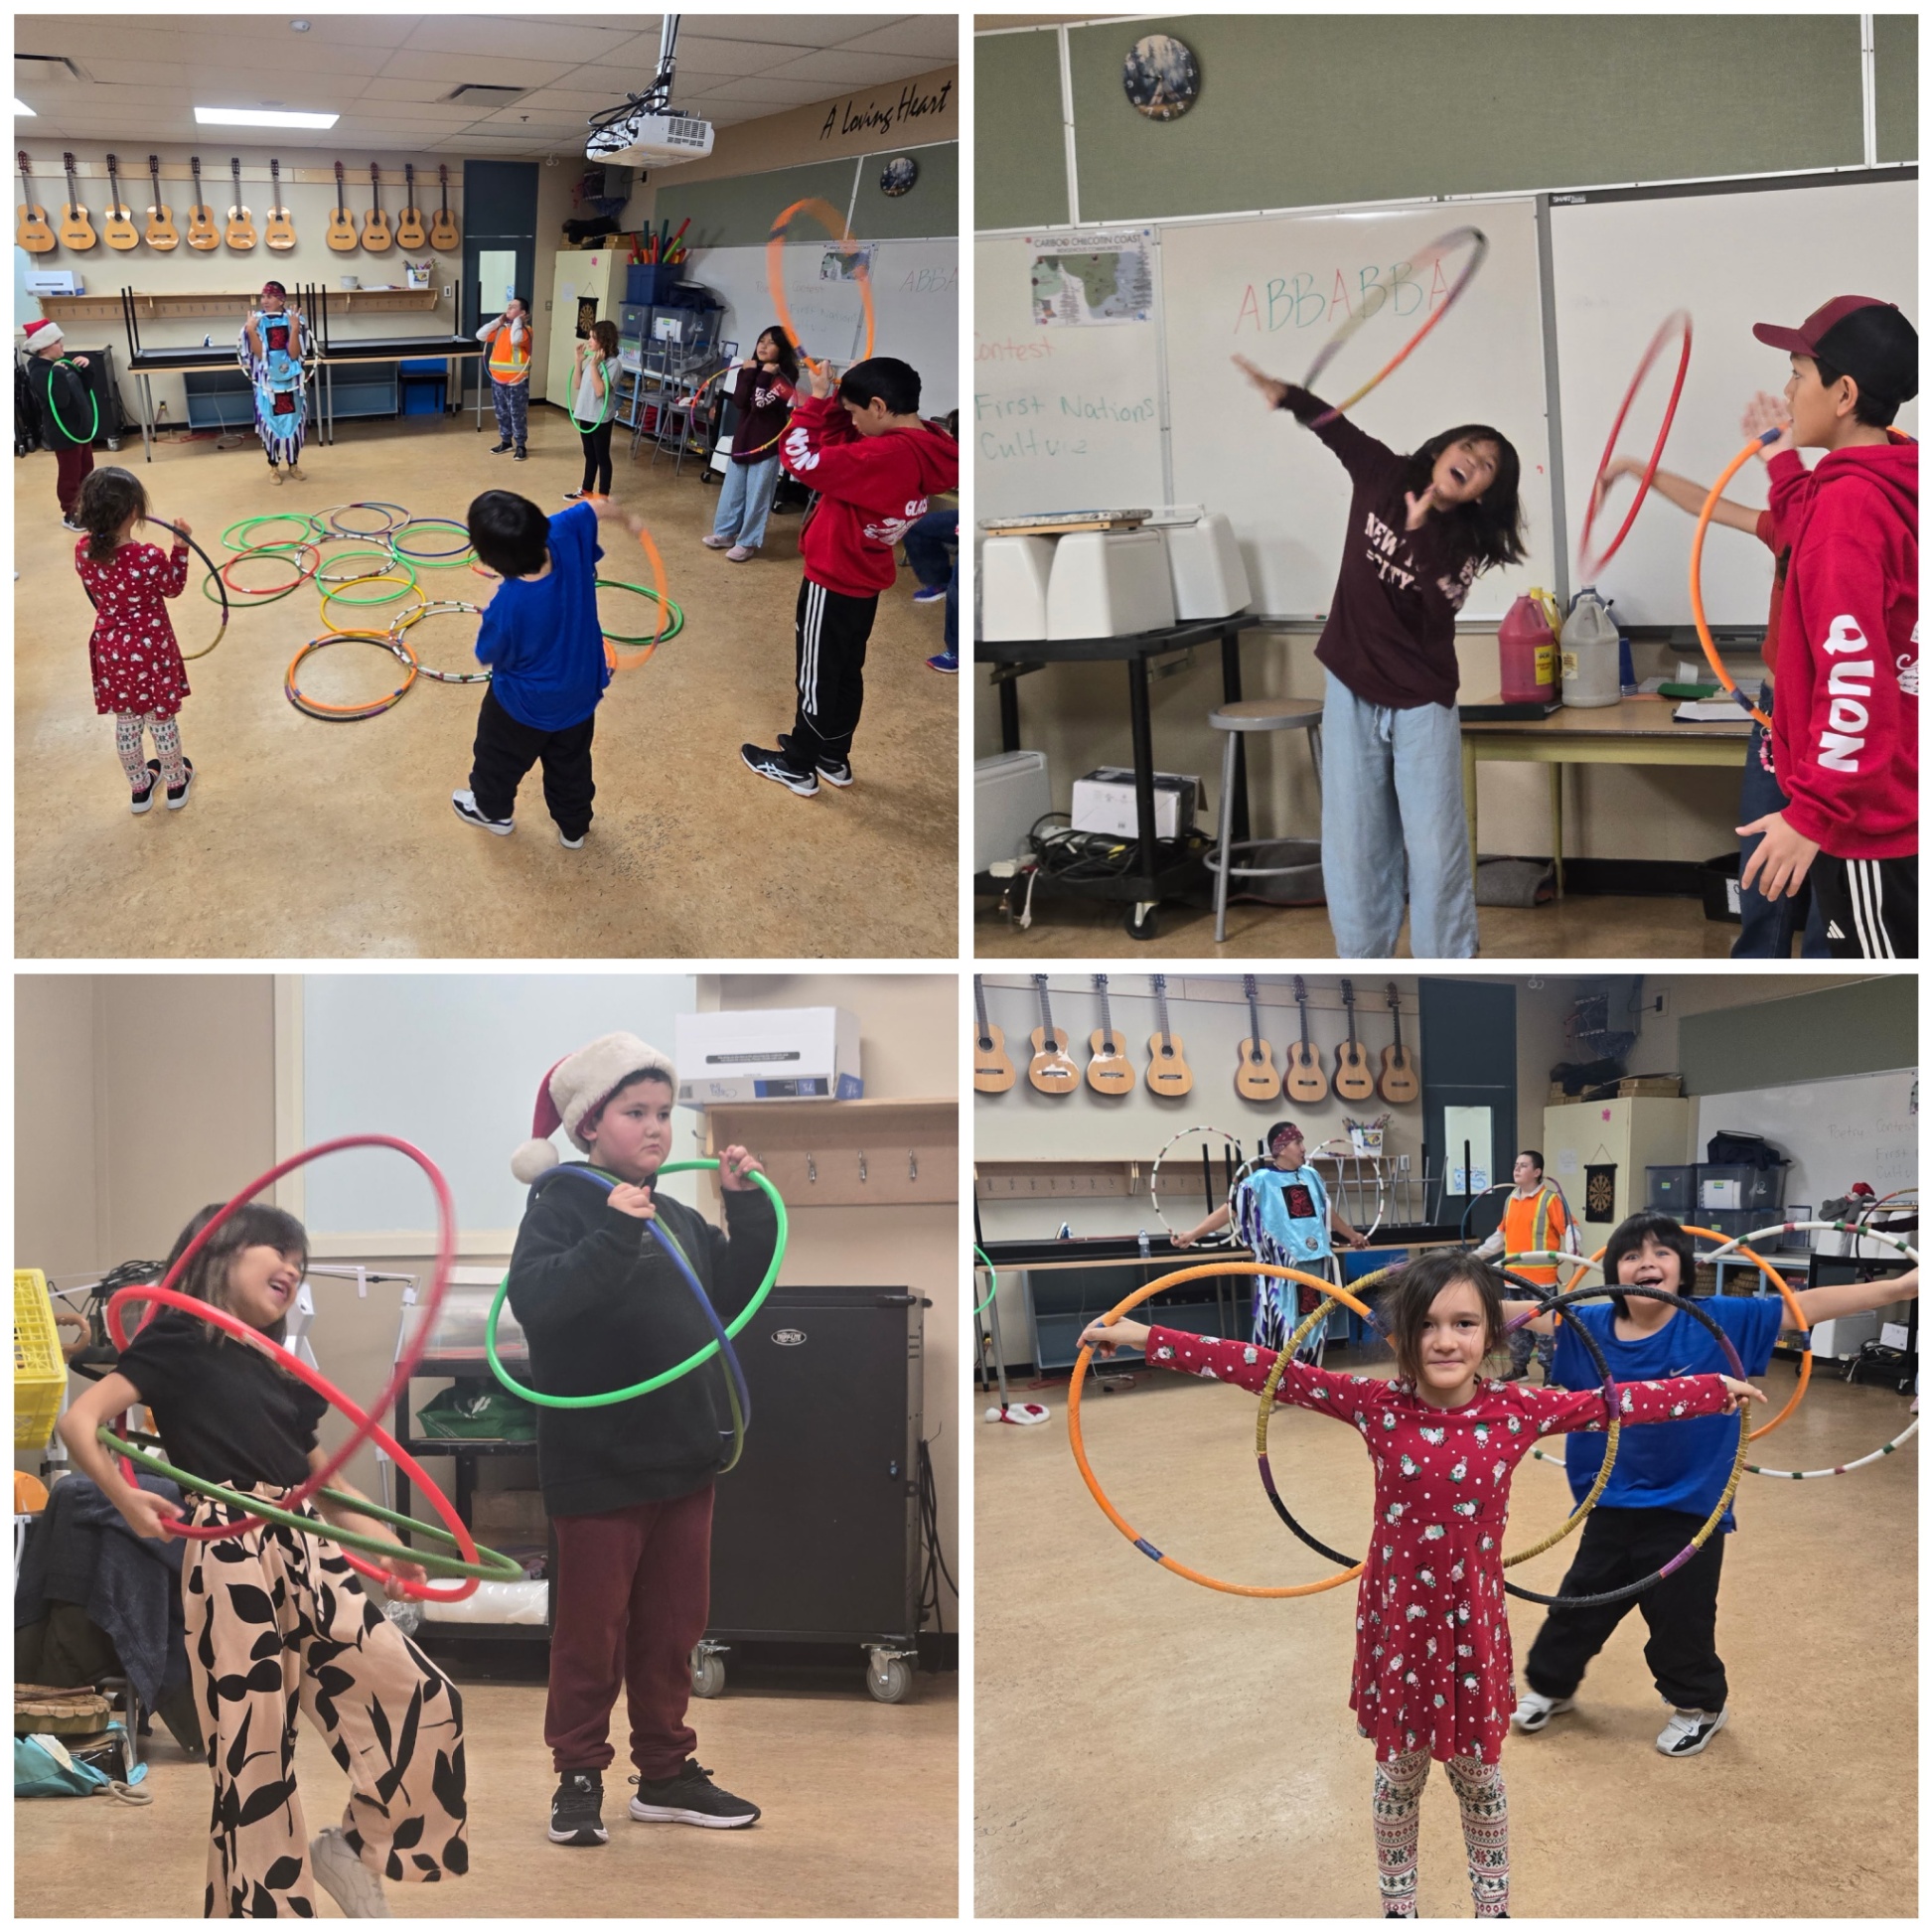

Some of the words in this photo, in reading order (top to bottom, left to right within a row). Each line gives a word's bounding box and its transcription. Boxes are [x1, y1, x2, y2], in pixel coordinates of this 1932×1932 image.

[1187, 69, 1194, 77] 3
[1126, 79, 1134, 88] 9
[819, 104, 837, 140] A
[841, 100, 894, 134] Loving
[897, 80, 952, 123] Heart
[1162, 108, 1170, 117] 6
[1114, 233, 1141, 244] COAST
[974, 393, 1045, 421] First
[1060, 396, 1154, 423] Nations
[1817, 614, 1874, 773] QUON
